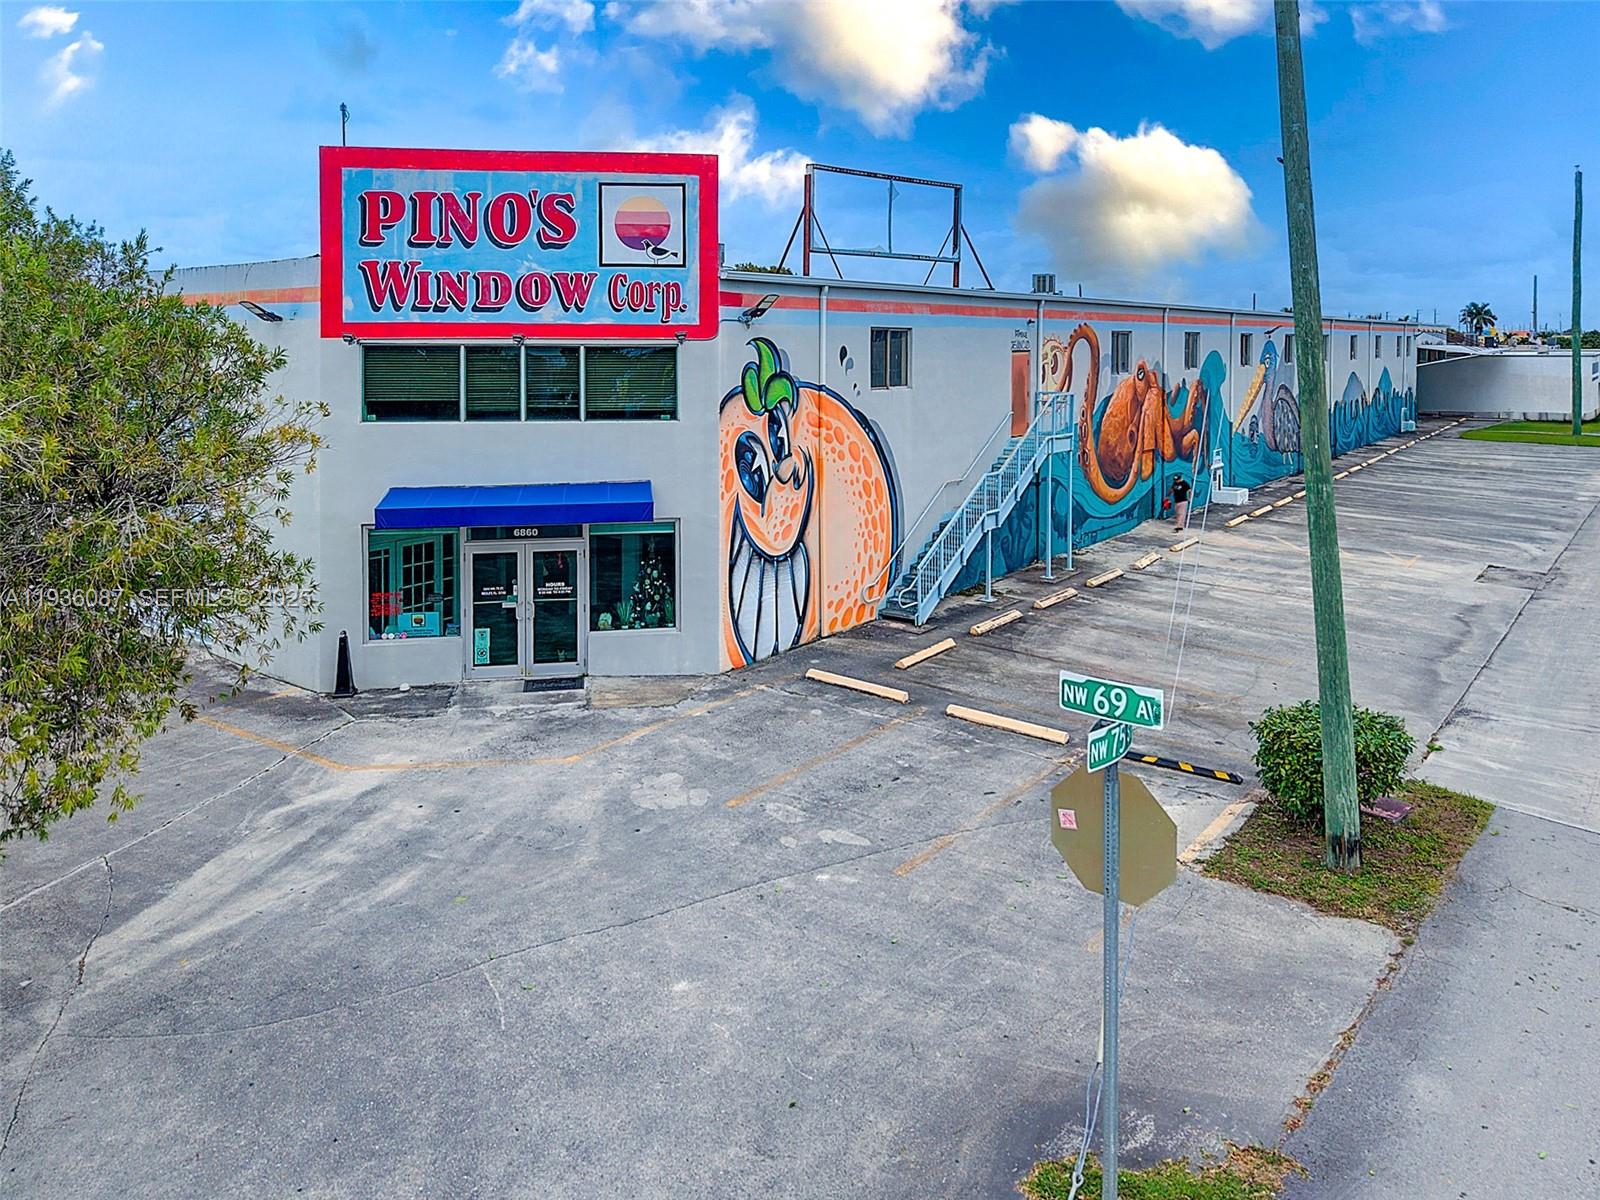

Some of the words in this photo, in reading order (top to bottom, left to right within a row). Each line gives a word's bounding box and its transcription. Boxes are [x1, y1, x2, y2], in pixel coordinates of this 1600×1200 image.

[358, 188, 578, 249] PINO'S
[357, 259, 599, 313] WINDOW
[606, 272, 689, 323] Corp.
[513, 528, 538, 537] 6860
[1063, 683, 1088, 706] NW
[1093, 685, 1127, 717] 69
[1090, 739, 1108, 764] NW
